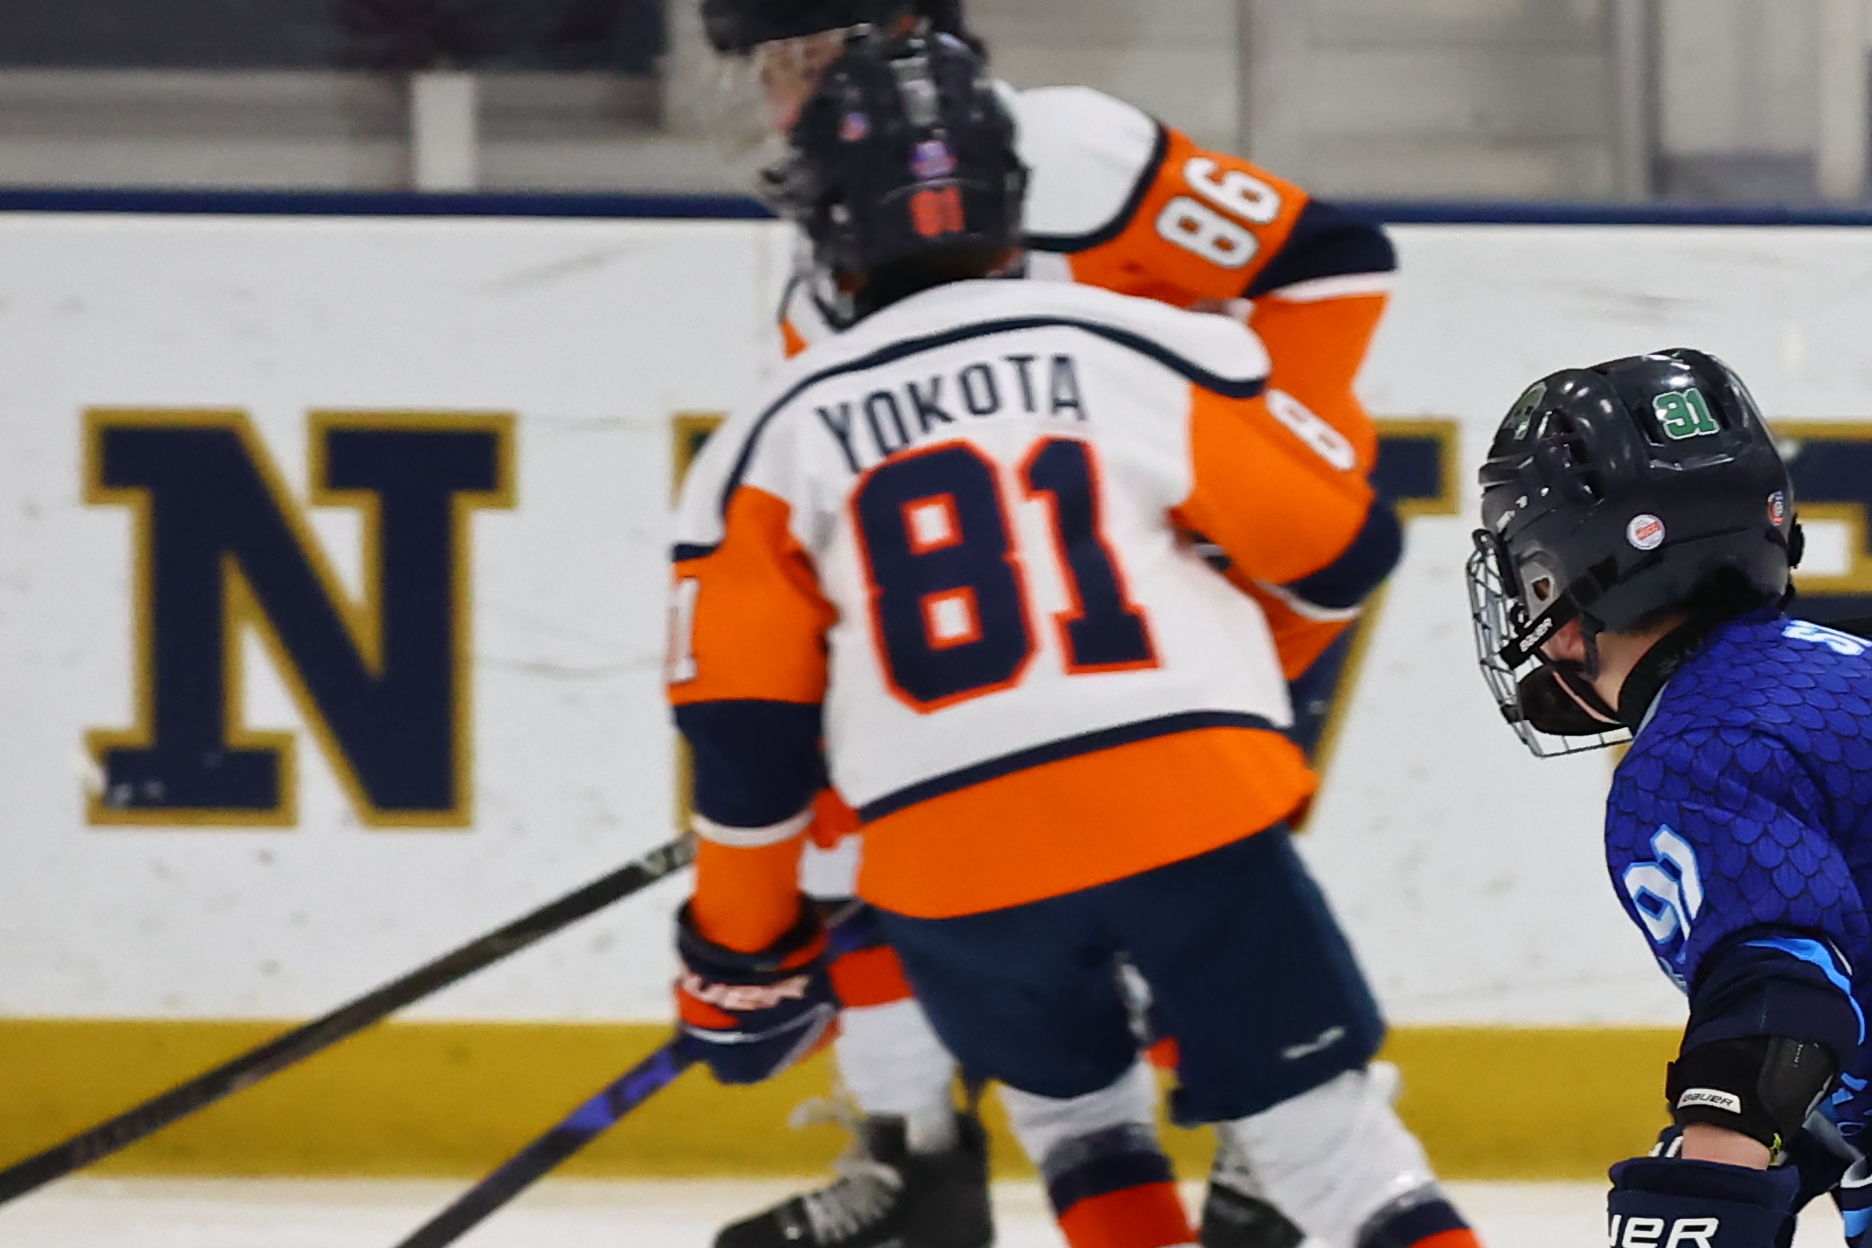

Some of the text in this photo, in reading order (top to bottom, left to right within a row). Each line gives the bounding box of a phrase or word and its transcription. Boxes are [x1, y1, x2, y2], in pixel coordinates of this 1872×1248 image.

[1154, 156, 1282, 270] 86
[814, 354, 1088, 475] YOKOTA
[848, 433, 1163, 714] 81
